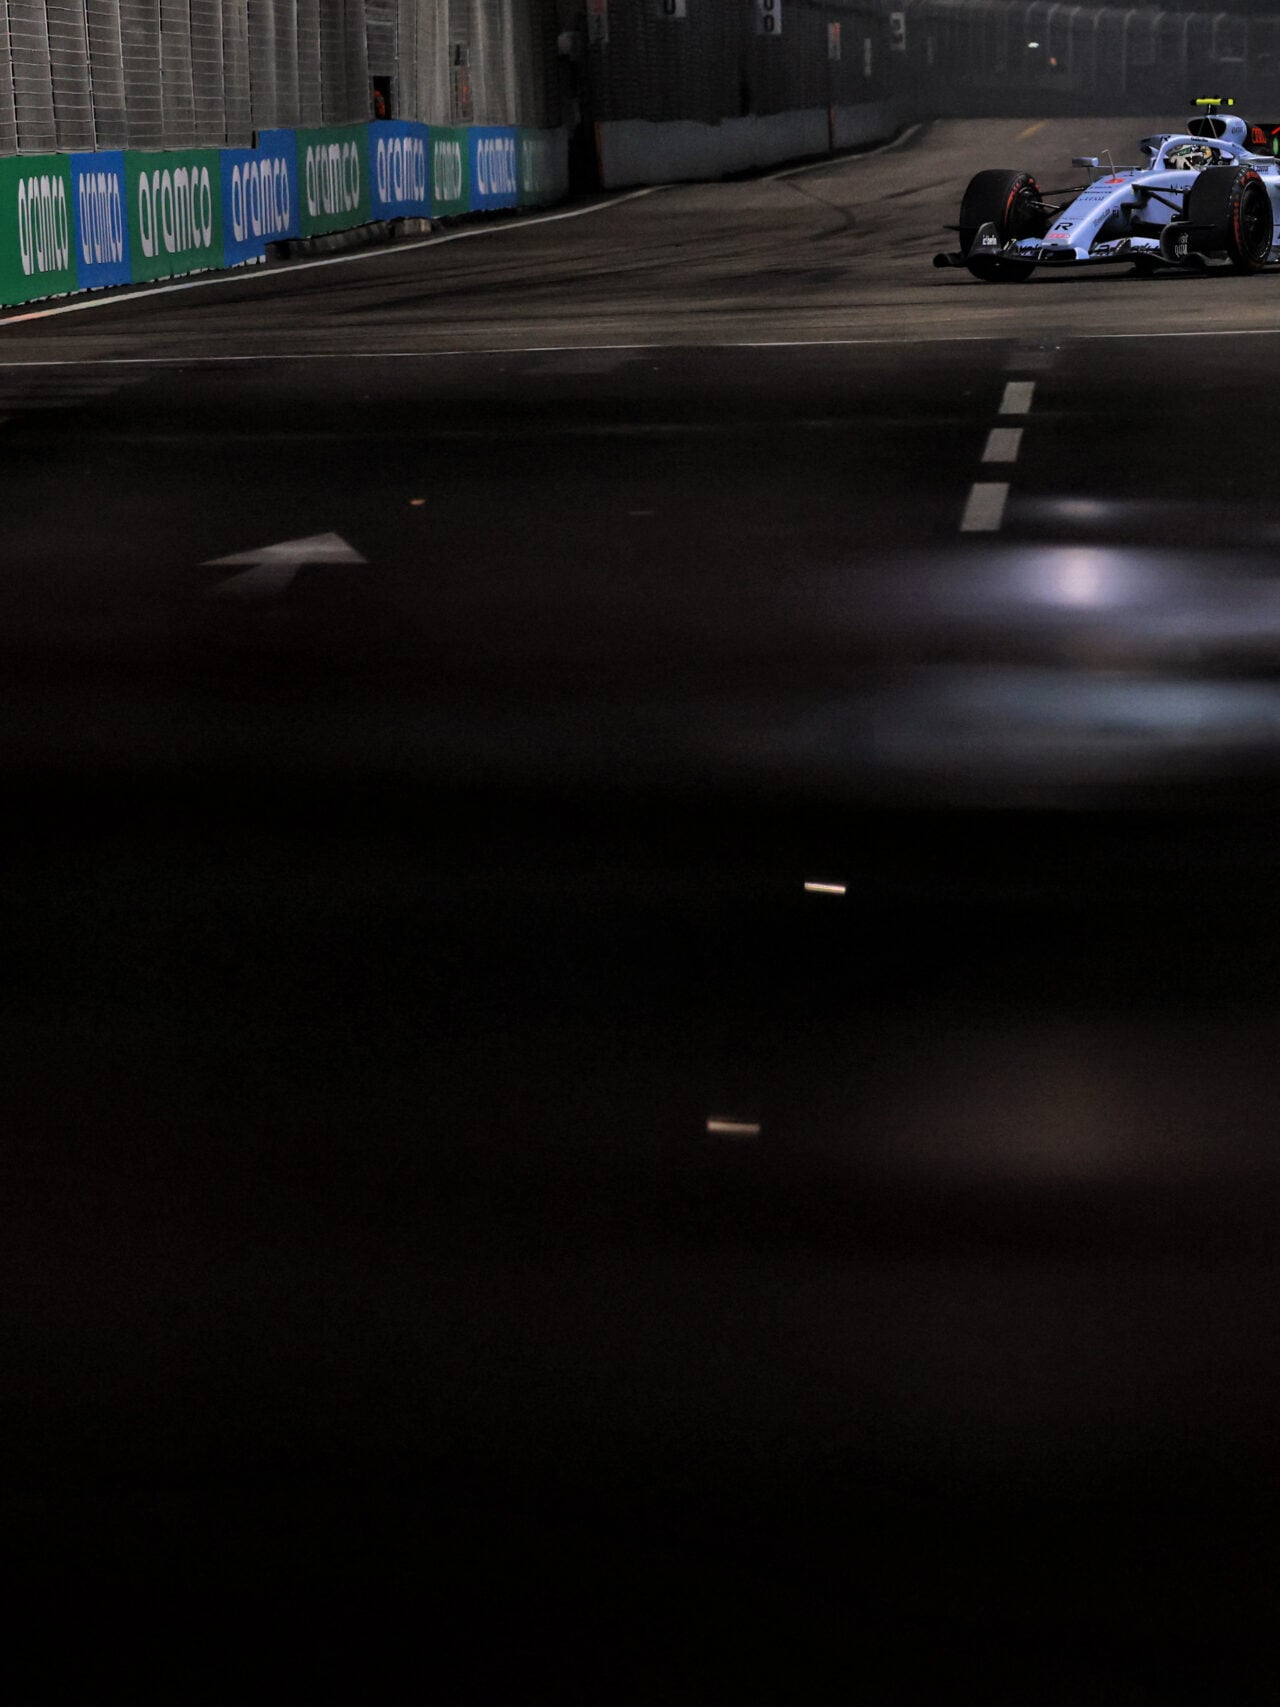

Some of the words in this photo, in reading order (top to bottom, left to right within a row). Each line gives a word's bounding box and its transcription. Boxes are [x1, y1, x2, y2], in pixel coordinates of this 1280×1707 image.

[138, 165, 212, 258] aramco
[231, 157, 290, 242] aramco
[305, 140, 360, 217] aramco
[377, 136, 425, 203] aramco
[18, 175, 69, 276] aramco
[79, 172, 123, 266] aramco
